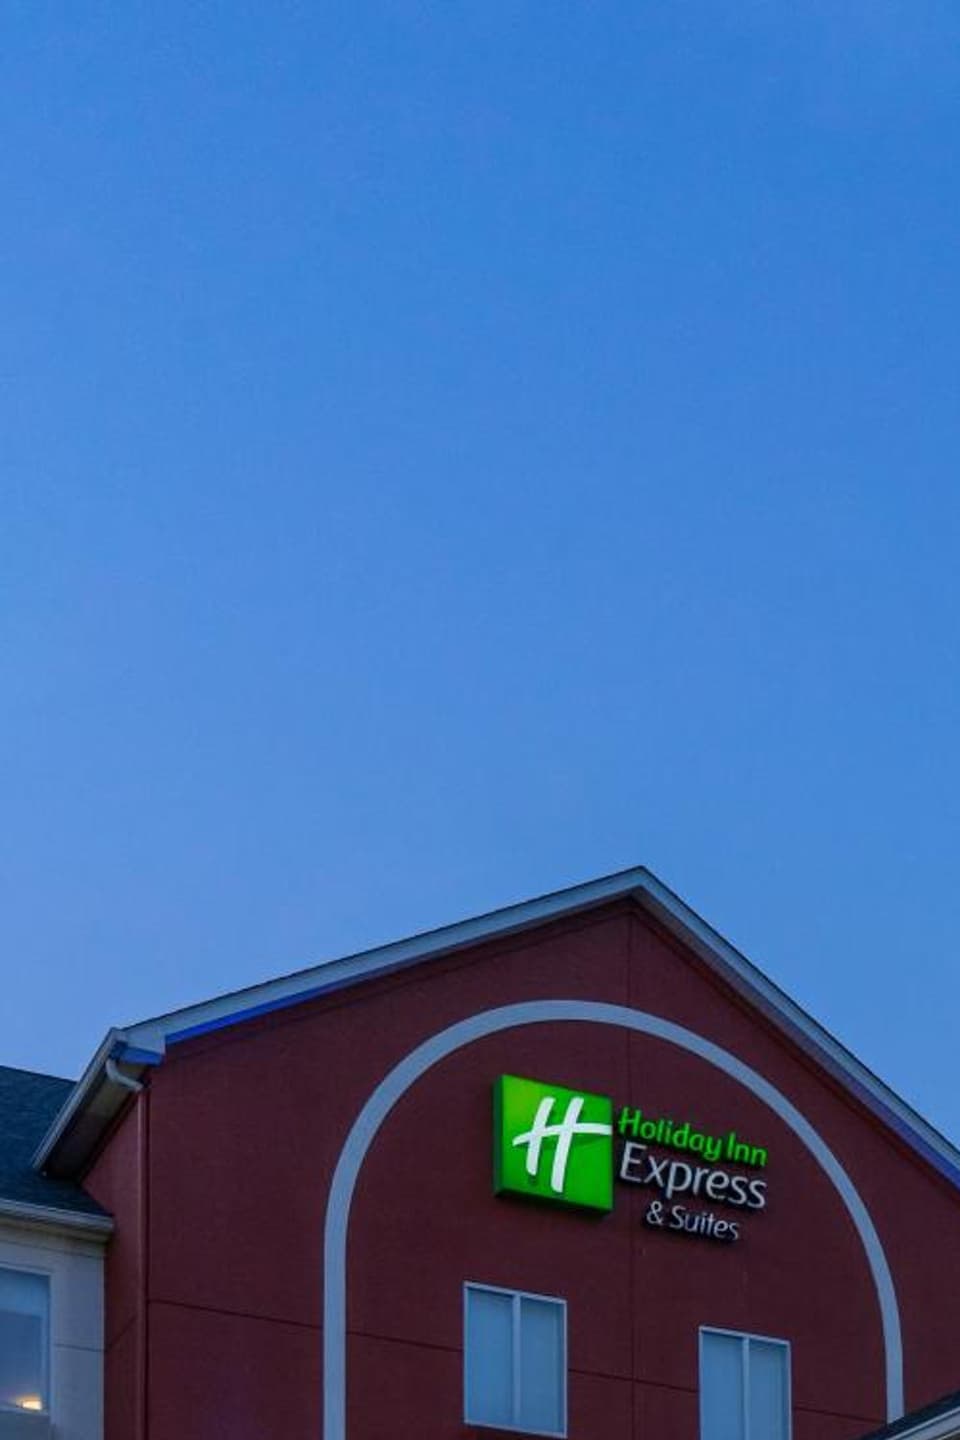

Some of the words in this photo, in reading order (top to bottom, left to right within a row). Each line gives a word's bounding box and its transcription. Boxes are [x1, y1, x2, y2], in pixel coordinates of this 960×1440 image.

[513, 1097, 612, 1192] H
[619, 1107, 721, 1161] Holiday
[728, 1134, 767, 1166] Inn
[620, 1142, 767, 1208] Express
[647, 1201, 663, 1225] &
[670, 1205, 739, 1240] Suites
